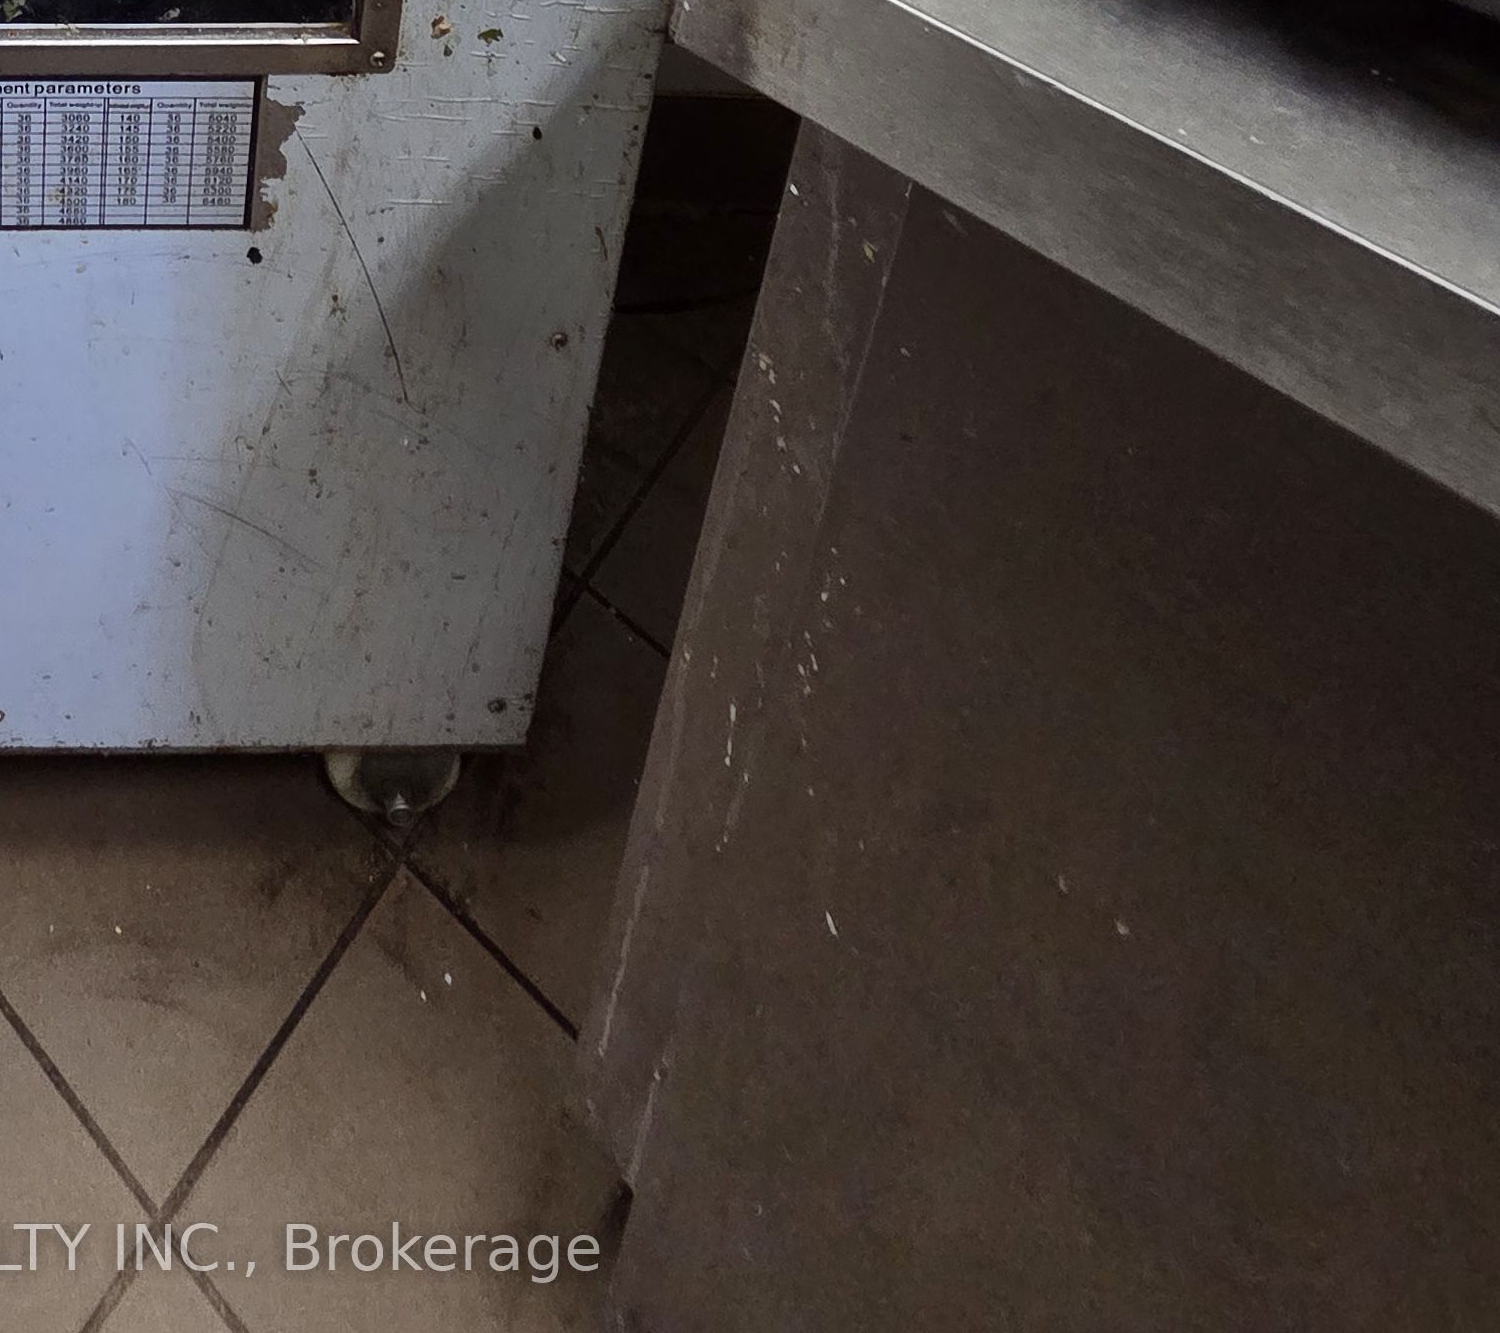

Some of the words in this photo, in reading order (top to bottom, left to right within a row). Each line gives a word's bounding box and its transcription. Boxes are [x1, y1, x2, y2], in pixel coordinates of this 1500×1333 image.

[34, 83, 142, 95] parameters
[17, 114, 32, 123] 36
[120, 114, 141, 122] 140
[167, 114, 181, 122] 36
[17, 125, 32, 133] 36
[120, 124, 140, 133] 145
[167, 124, 181, 133] 36
[17, 136, 31, 144] 36
[119, 135, 140, 144] 150
[166, 135, 180, 144] 36
[17, 145, 31, 154] 36
[119, 146, 139, 154] 155
[165, 146, 179, 154] 36
[17, 156, 31, 164] 36
[118, 156, 138, 164] 160
[165, 156, 179, 165] 36
[16, 167, 31, 175] 36
[118, 166, 138, 175] 165
[164, 166, 178, 175] 36
[16, 177, 31, 186] 36
[117, 176, 137, 185] 170
[163, 176, 177, 184] 36
[16, 187, 31, 196] 36
[117, 186, 137, 195] 175
[163, 186, 177, 195] 36
[16, 196, 30, 205] 36
[116, 197, 136, 205] 180
[162, 195, 176, 204] 36
[16, 206, 30, 214] 36
